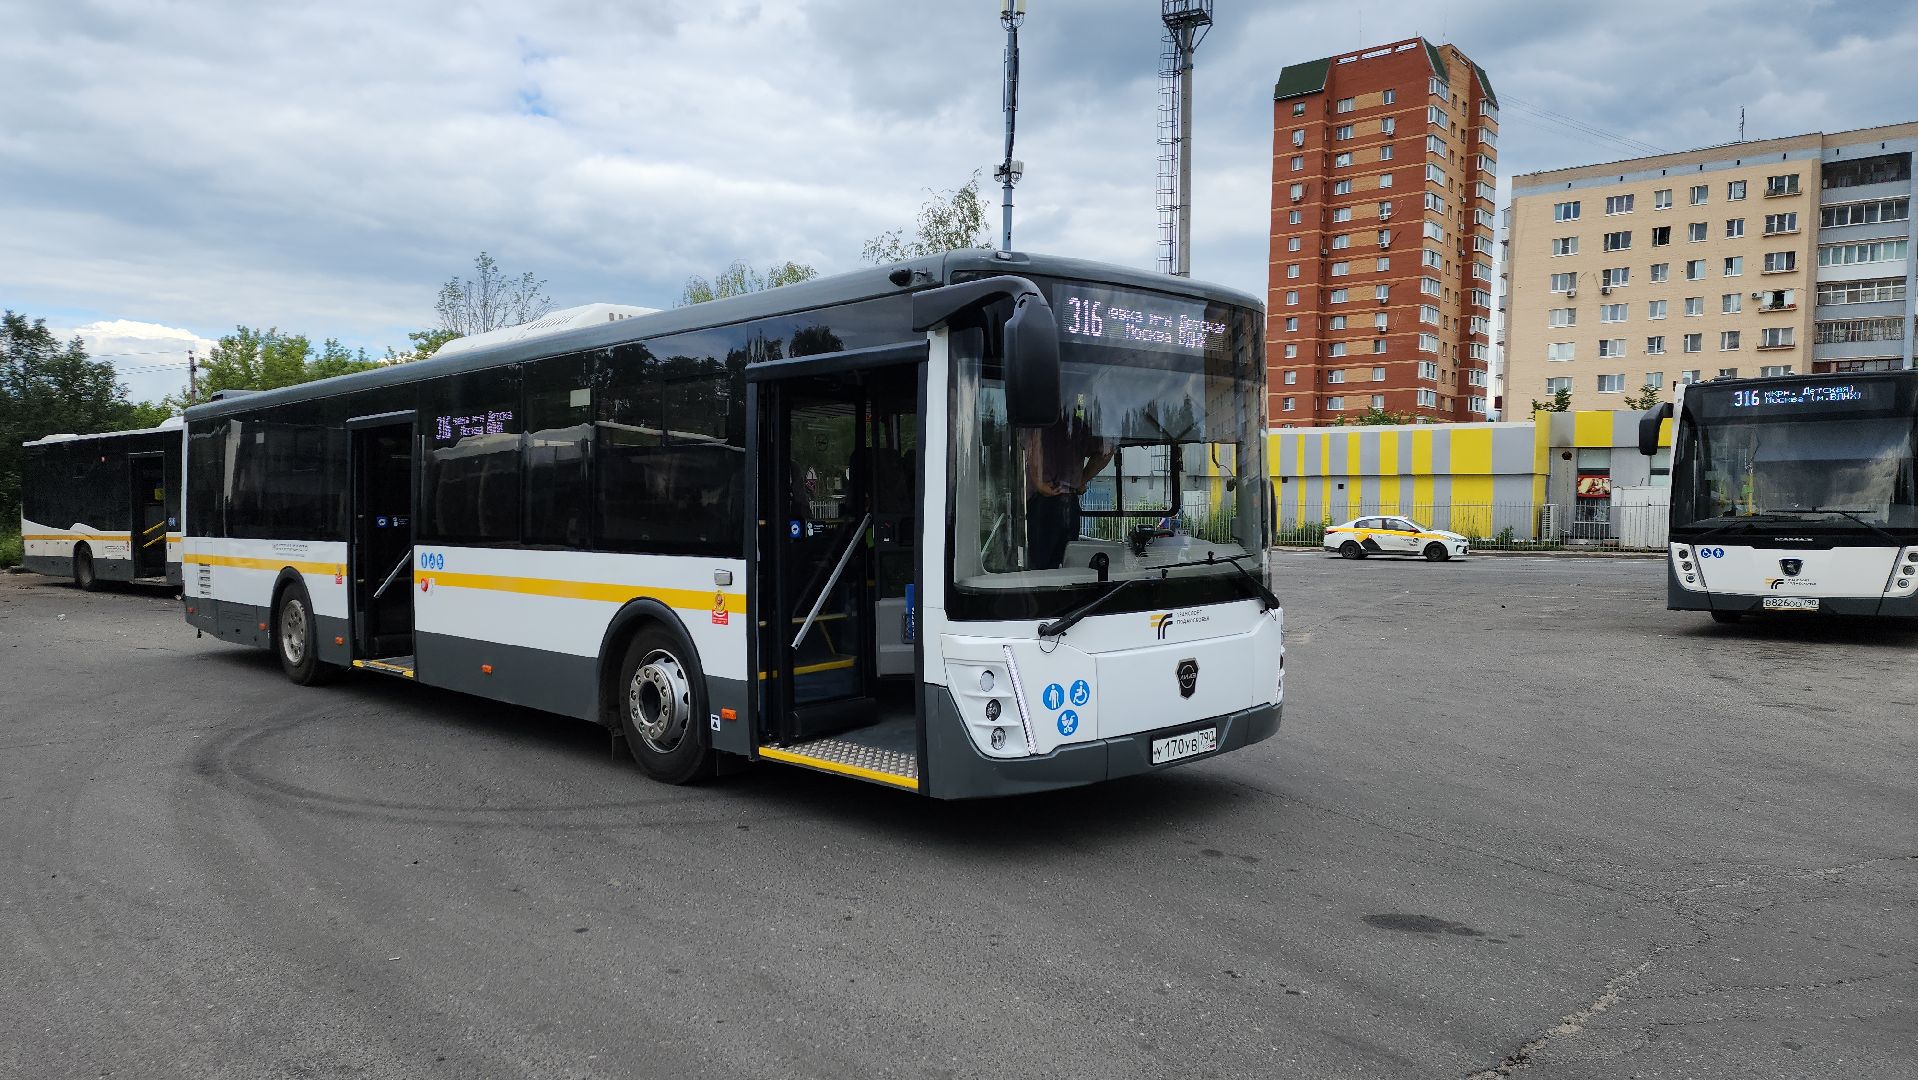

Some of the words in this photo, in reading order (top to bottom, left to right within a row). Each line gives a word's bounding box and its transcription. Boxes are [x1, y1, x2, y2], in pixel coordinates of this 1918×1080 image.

[1068, 297, 1102, 336] 316
[1125, 322, 1172, 344] Москва
[1734, 390, 1760, 406] 316
[1765, 396, 1804, 404] Москва
[1199, 730, 1216, 745] 790
